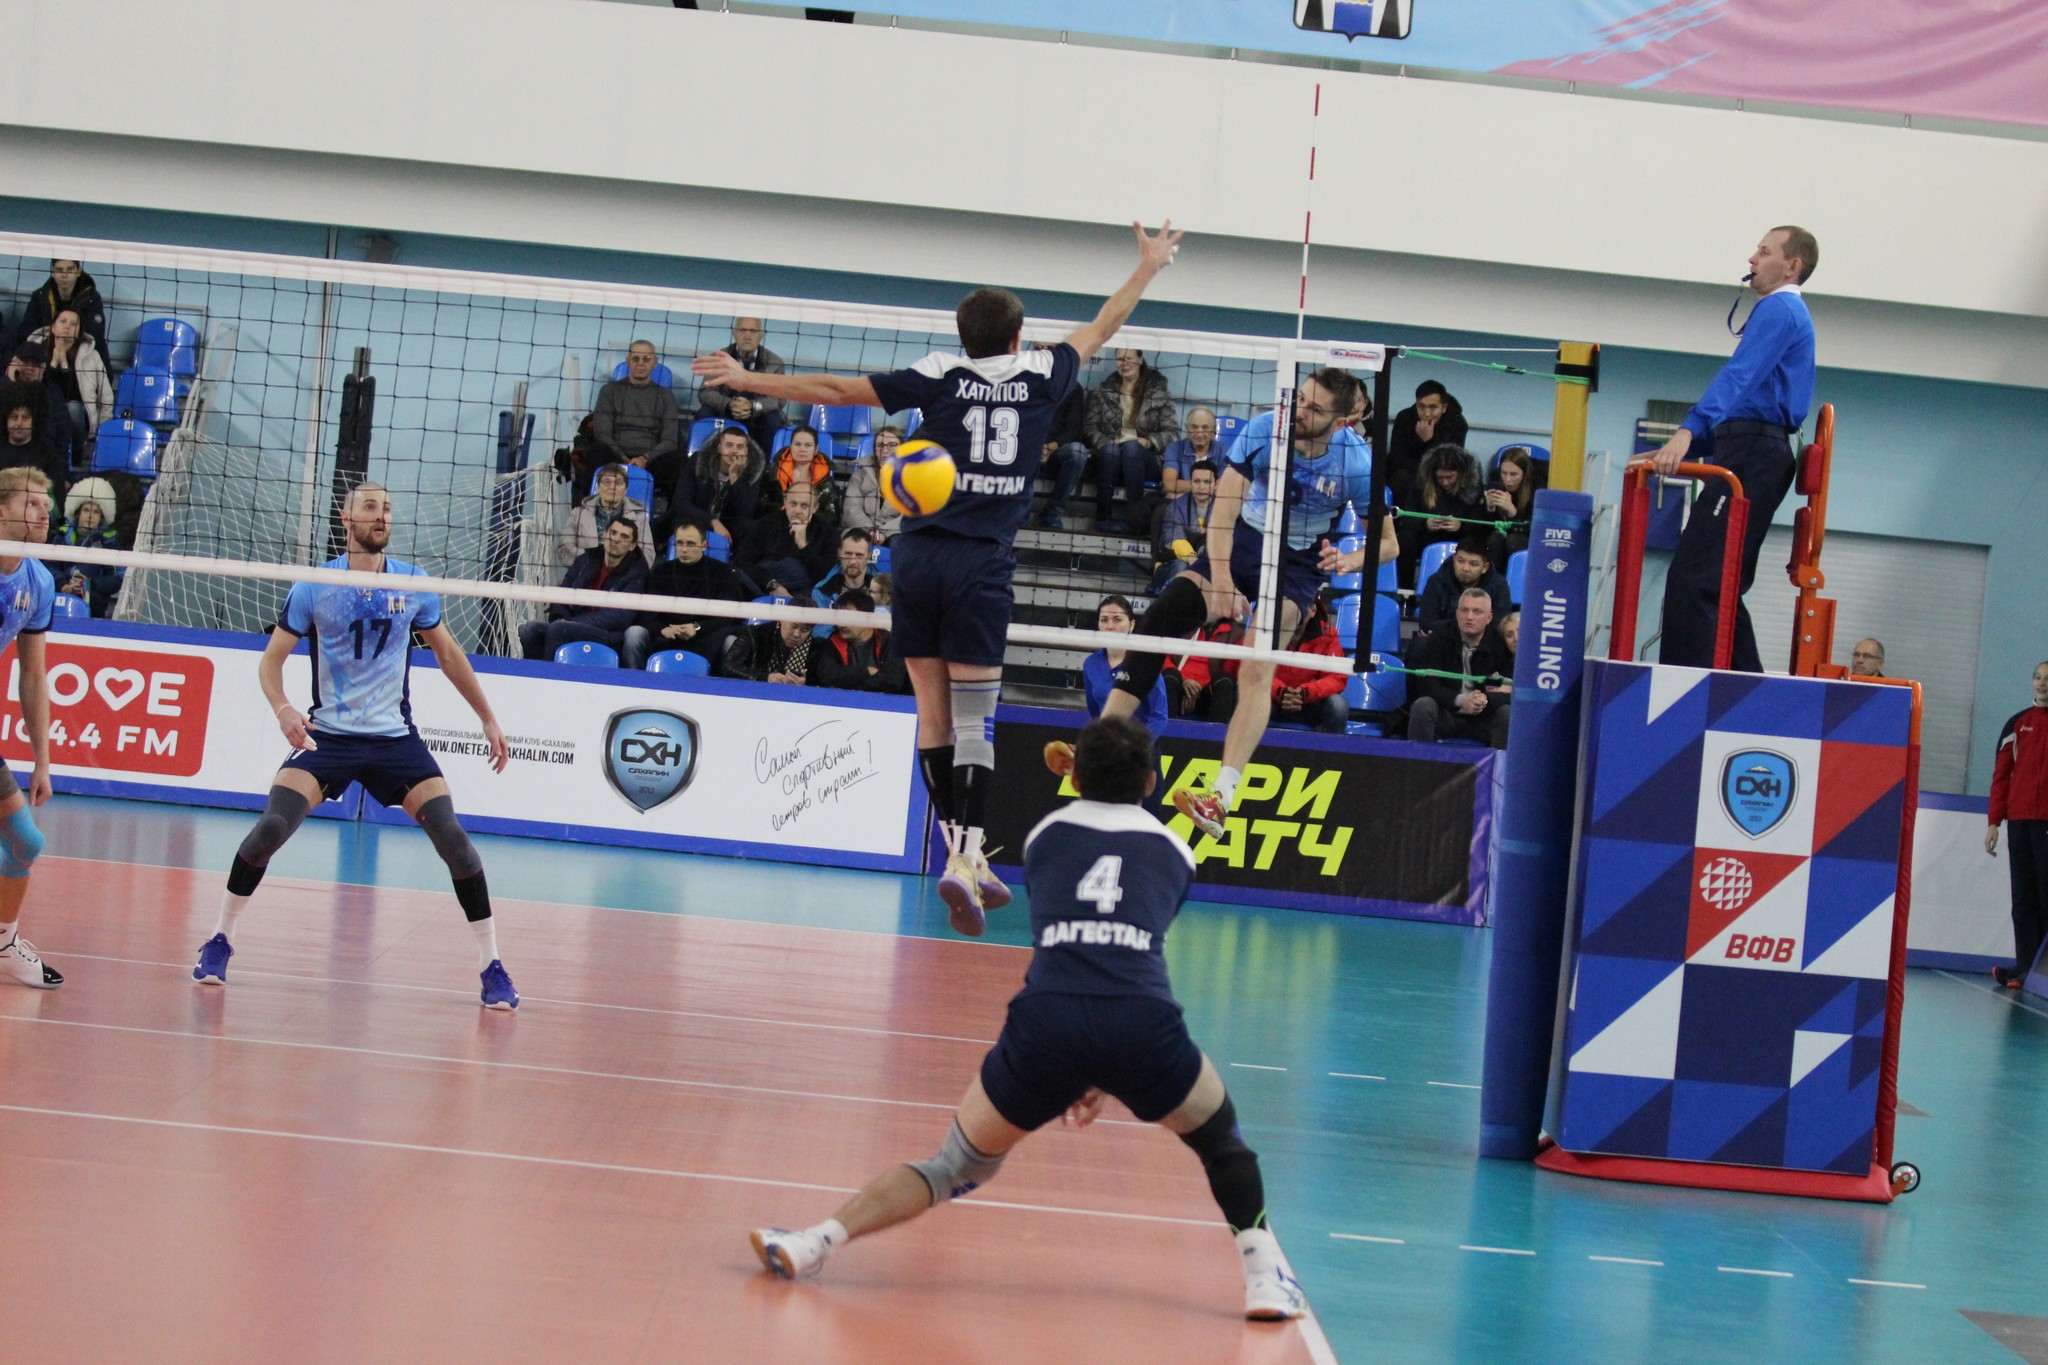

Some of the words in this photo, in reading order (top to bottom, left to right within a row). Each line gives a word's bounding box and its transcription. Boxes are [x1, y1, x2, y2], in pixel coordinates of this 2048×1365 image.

[955, 378, 1029, 402] ХАТИПОВ
[962, 406, 1020, 466] 13
[1545, 528, 1571, 540] FIVB
[349, 618, 393, 660] 17
[1537, 590, 1567, 690] JINLING
[117, 725, 179, 756] FM
[421, 727, 485, 740] ПРОФЕССИОНАЛЬНЫЙ
[524, 737, 540, 746] КЛУБ
[1076, 854, 1124, 914] 4
[1041, 920, 1153, 951] ДАГЕСТАН
[1724, 933, 1796, 963] ВФВ
